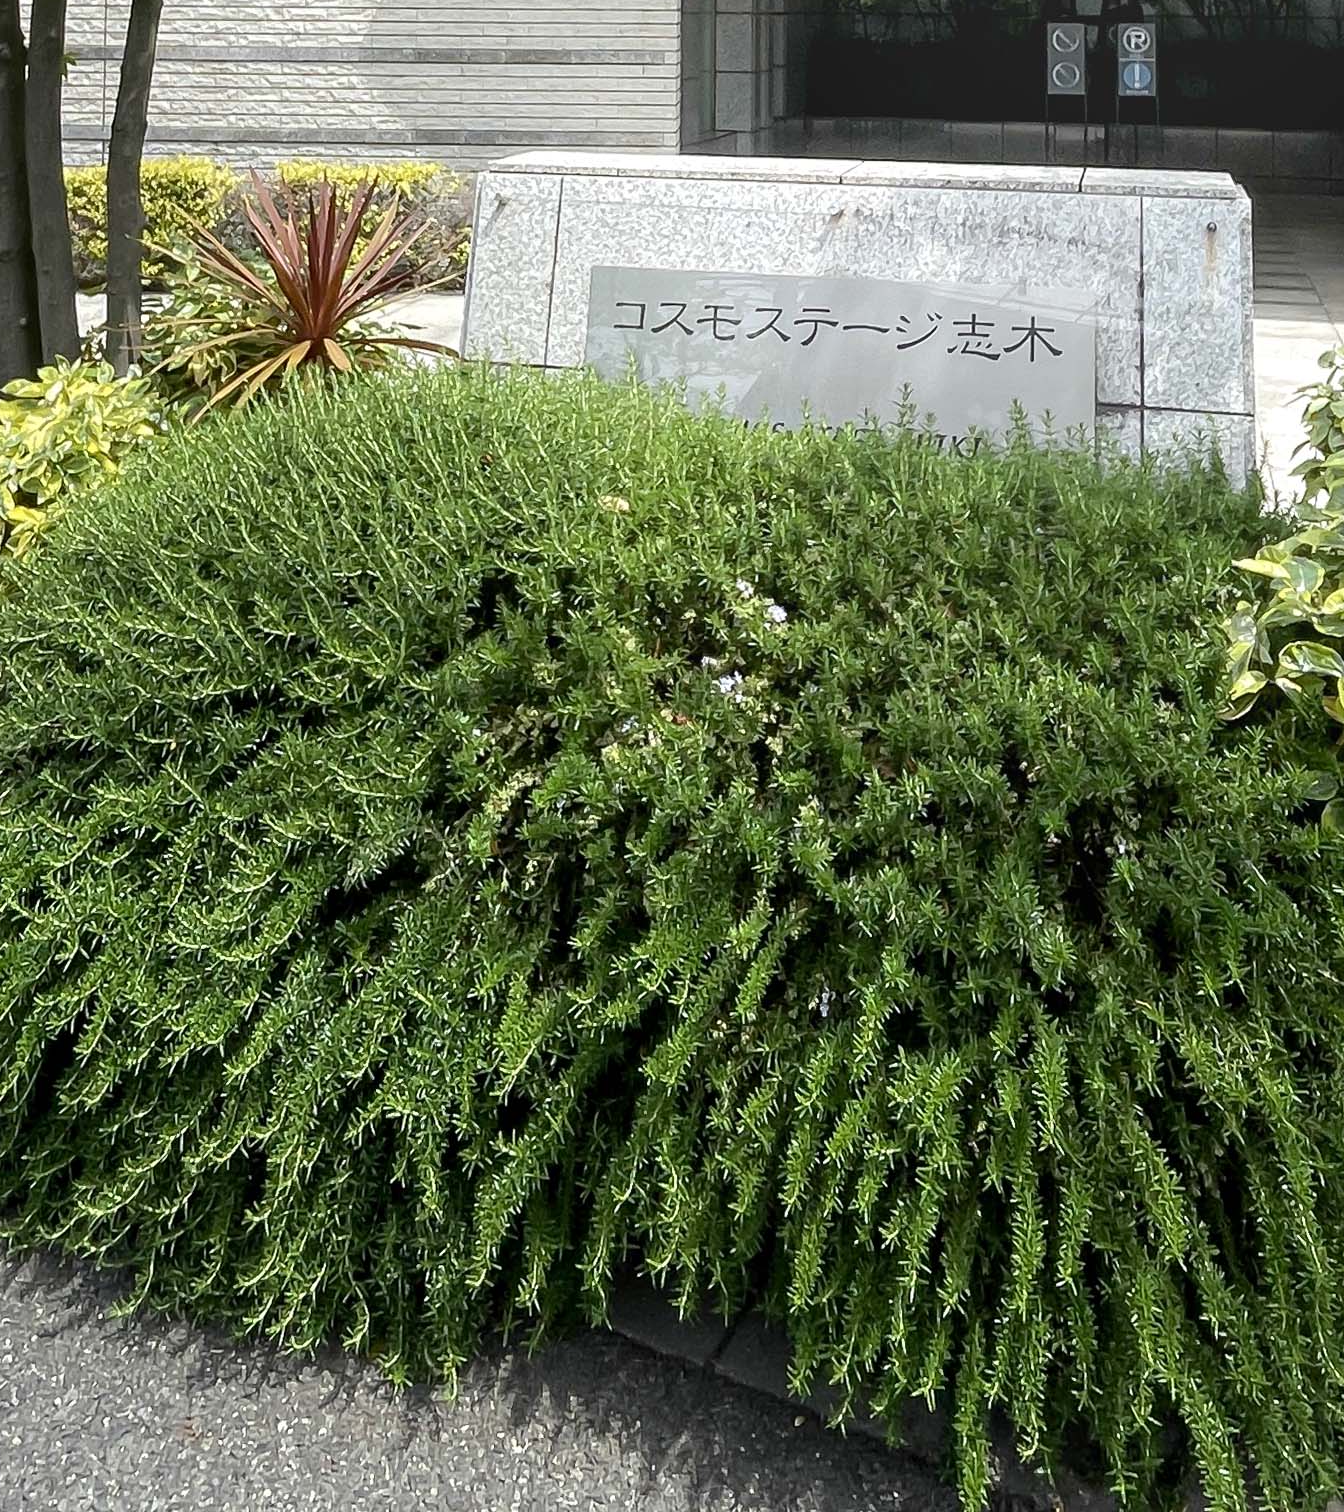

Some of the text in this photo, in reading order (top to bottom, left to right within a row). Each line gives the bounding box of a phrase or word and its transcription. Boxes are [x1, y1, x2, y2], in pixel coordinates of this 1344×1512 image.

[613, 301, 1063, 363] コスモステージ志木
